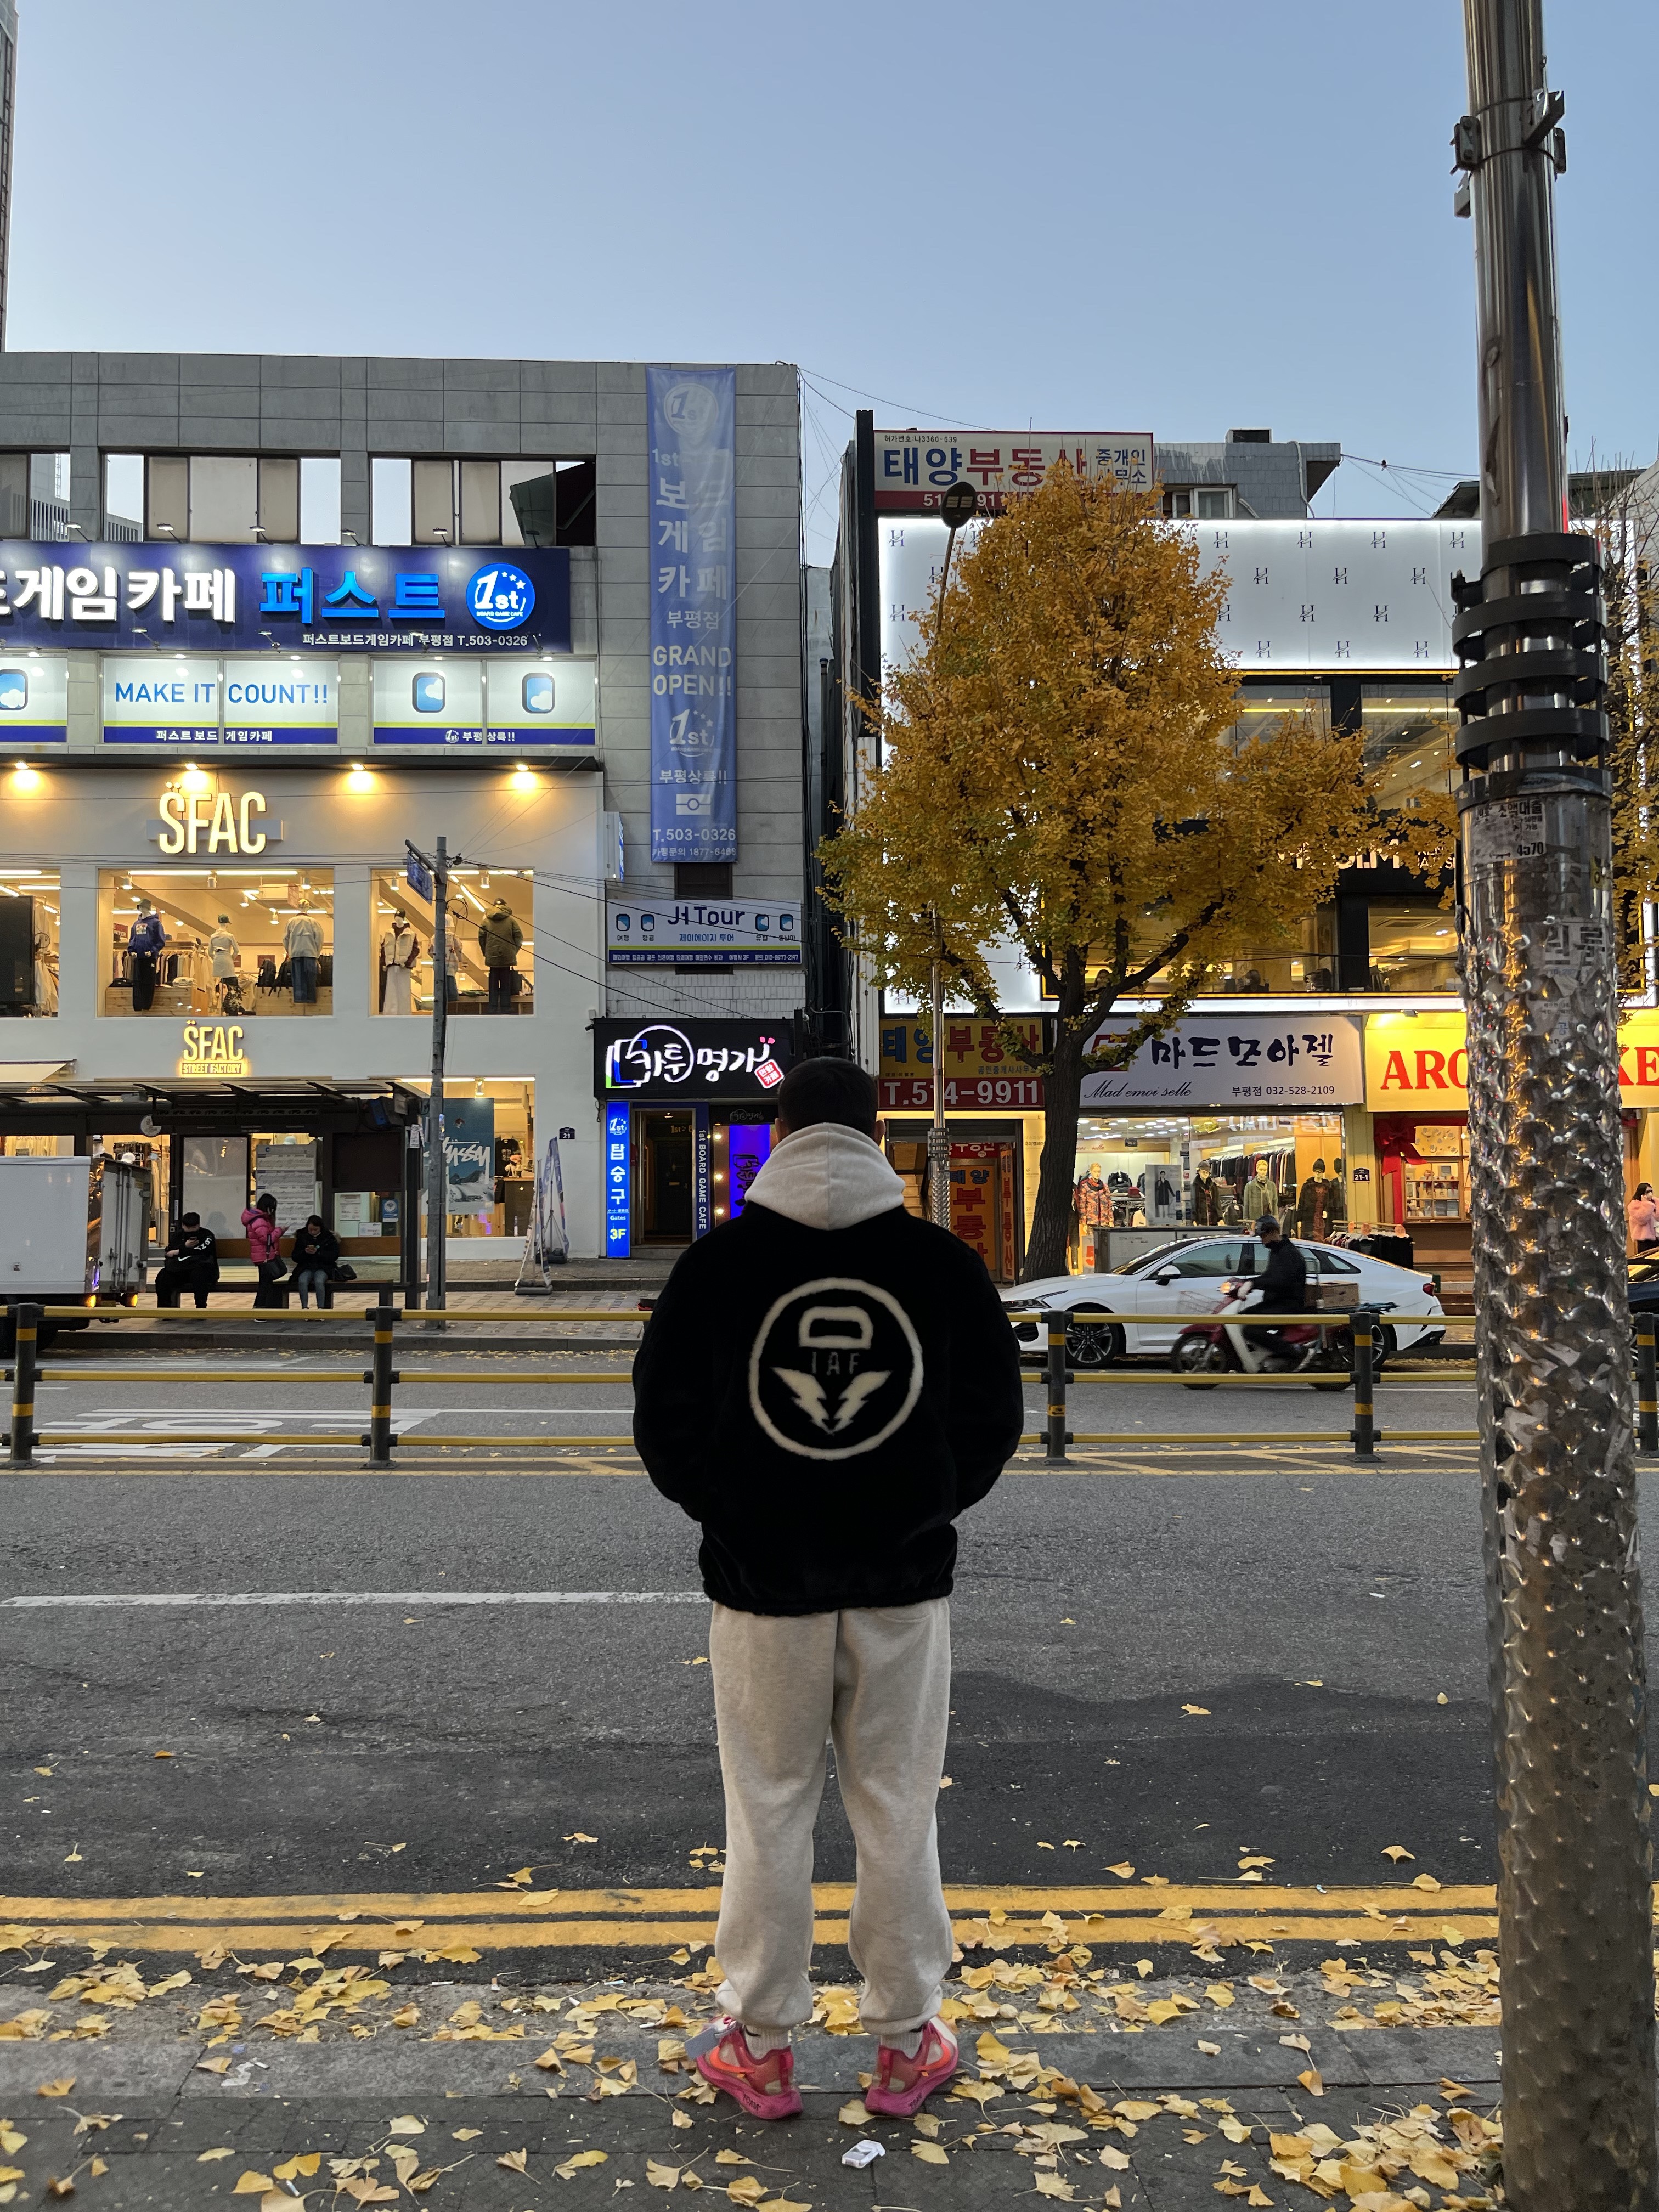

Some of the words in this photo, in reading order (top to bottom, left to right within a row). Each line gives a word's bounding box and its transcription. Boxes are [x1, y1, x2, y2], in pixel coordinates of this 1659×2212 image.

[652, 448, 679, 466] 1st
[0, 567, 117, 622] 게임
[259, 567, 445, 624] 퍼스트
[475, 571, 519, 609] 1st
[667, 610, 719, 629] 부평점
[419, 635, 453, 646] 부평점
[458, 635, 528, 647] T.503-0326
[653, 645, 731, 668] GRAND
[116, 684, 185, 703] MAKE
[195, 684, 215, 702] IT
[228, 684, 328, 703] COUNT!!
[653, 828, 736, 842] T.503-0326
[693, 906, 746, 926] Tour
[719, 934, 734, 942] 투어
[183, 1064, 209, 1074] STREET
[210, 1063, 241, 1074] FACTORY
[884, 1081, 1038, 1105] T.54-9911
[1084, 1080, 1128, 1098] Mad
[1161, 1082, 1192, 1096] selle
[1232, 1086, 1262, 1097] 부평점
[1266, 1086, 1335, 1095] 032-528-2109
[698, 1145, 707, 1173] BOARD
[611, 1144, 626, 1205] 탑승구
[698, 1178, 707, 1203] GAME
[698, 1207, 707, 1229] CAFE
[610, 1228, 627, 1240] 3F
